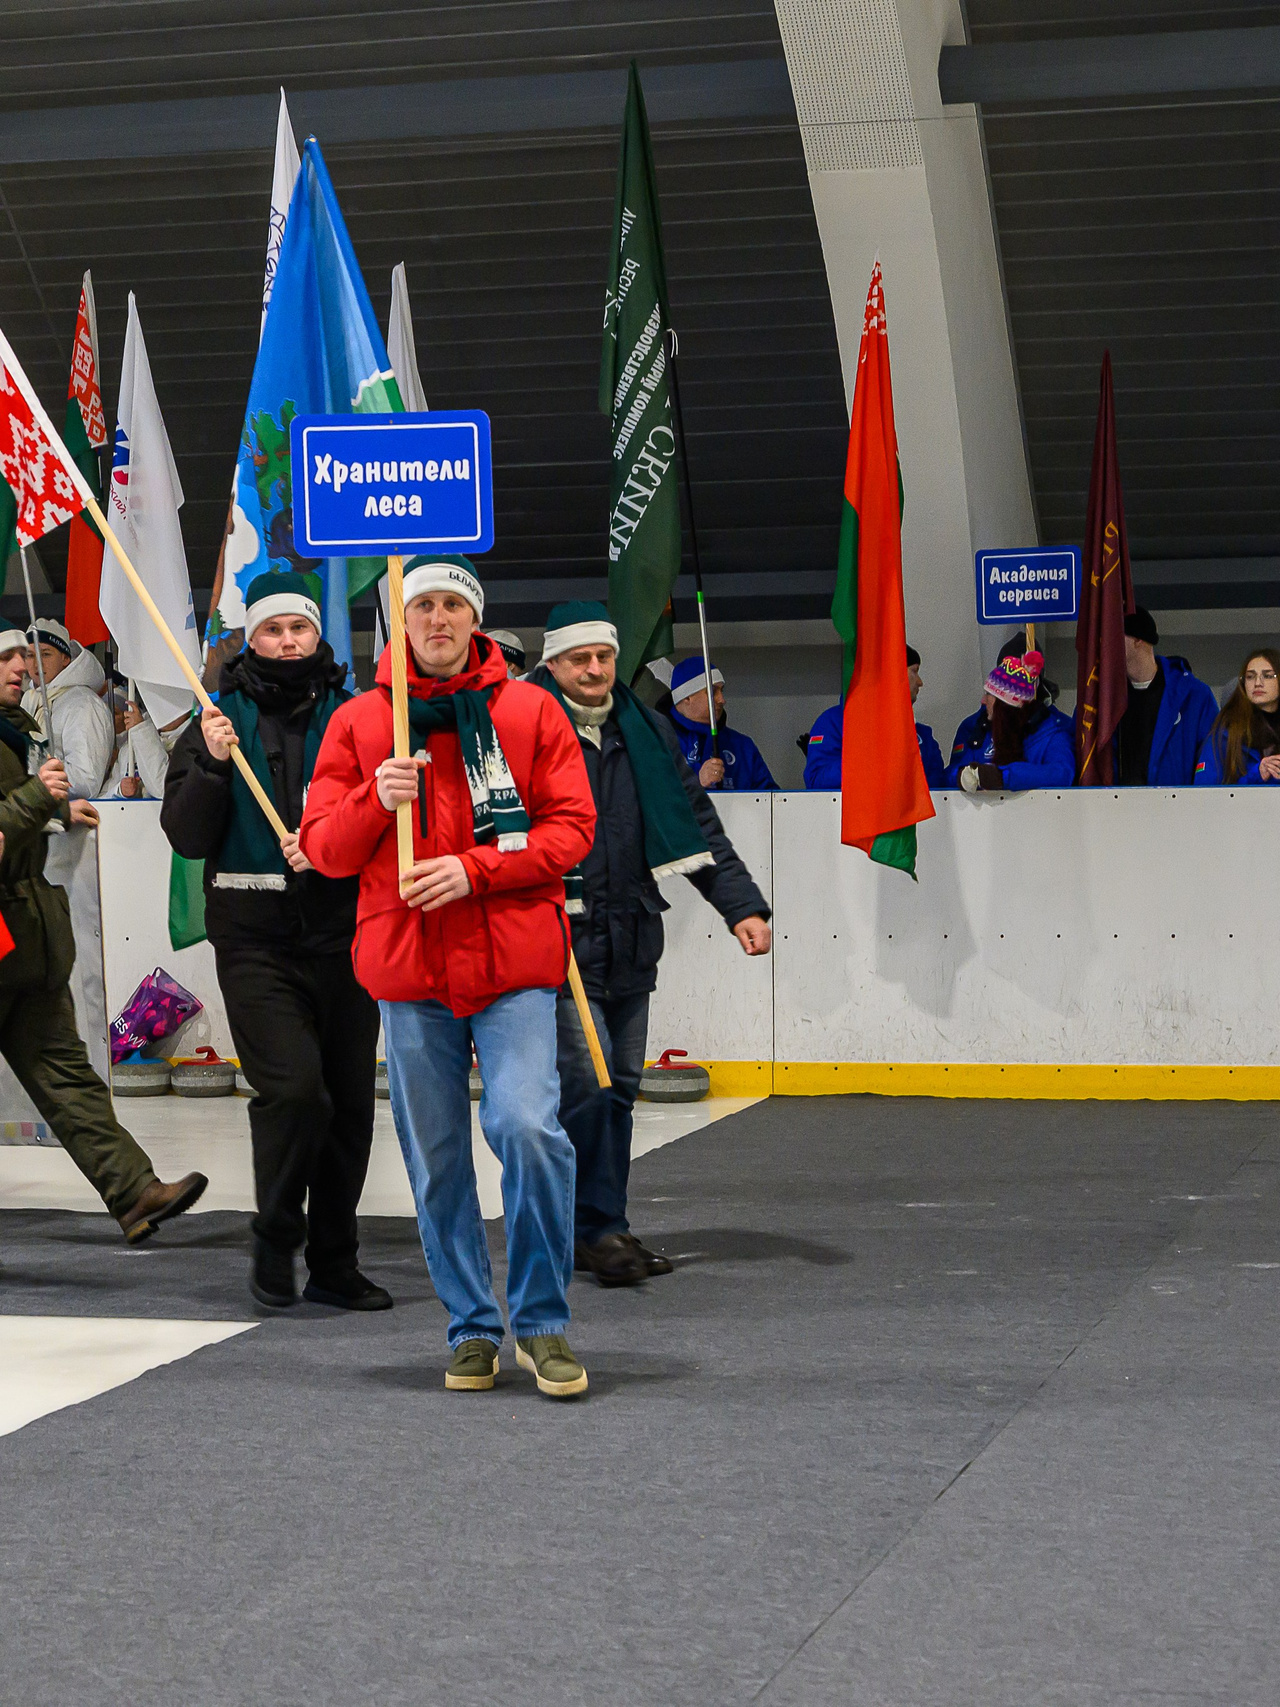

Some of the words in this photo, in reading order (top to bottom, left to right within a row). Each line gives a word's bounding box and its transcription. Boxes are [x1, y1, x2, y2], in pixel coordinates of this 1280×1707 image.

[314, 453, 470, 493] Хранители
[364, 494, 422, 518] леса
[989, 564, 1068, 585] Академия
[999, 587, 1059, 607] сервиса
